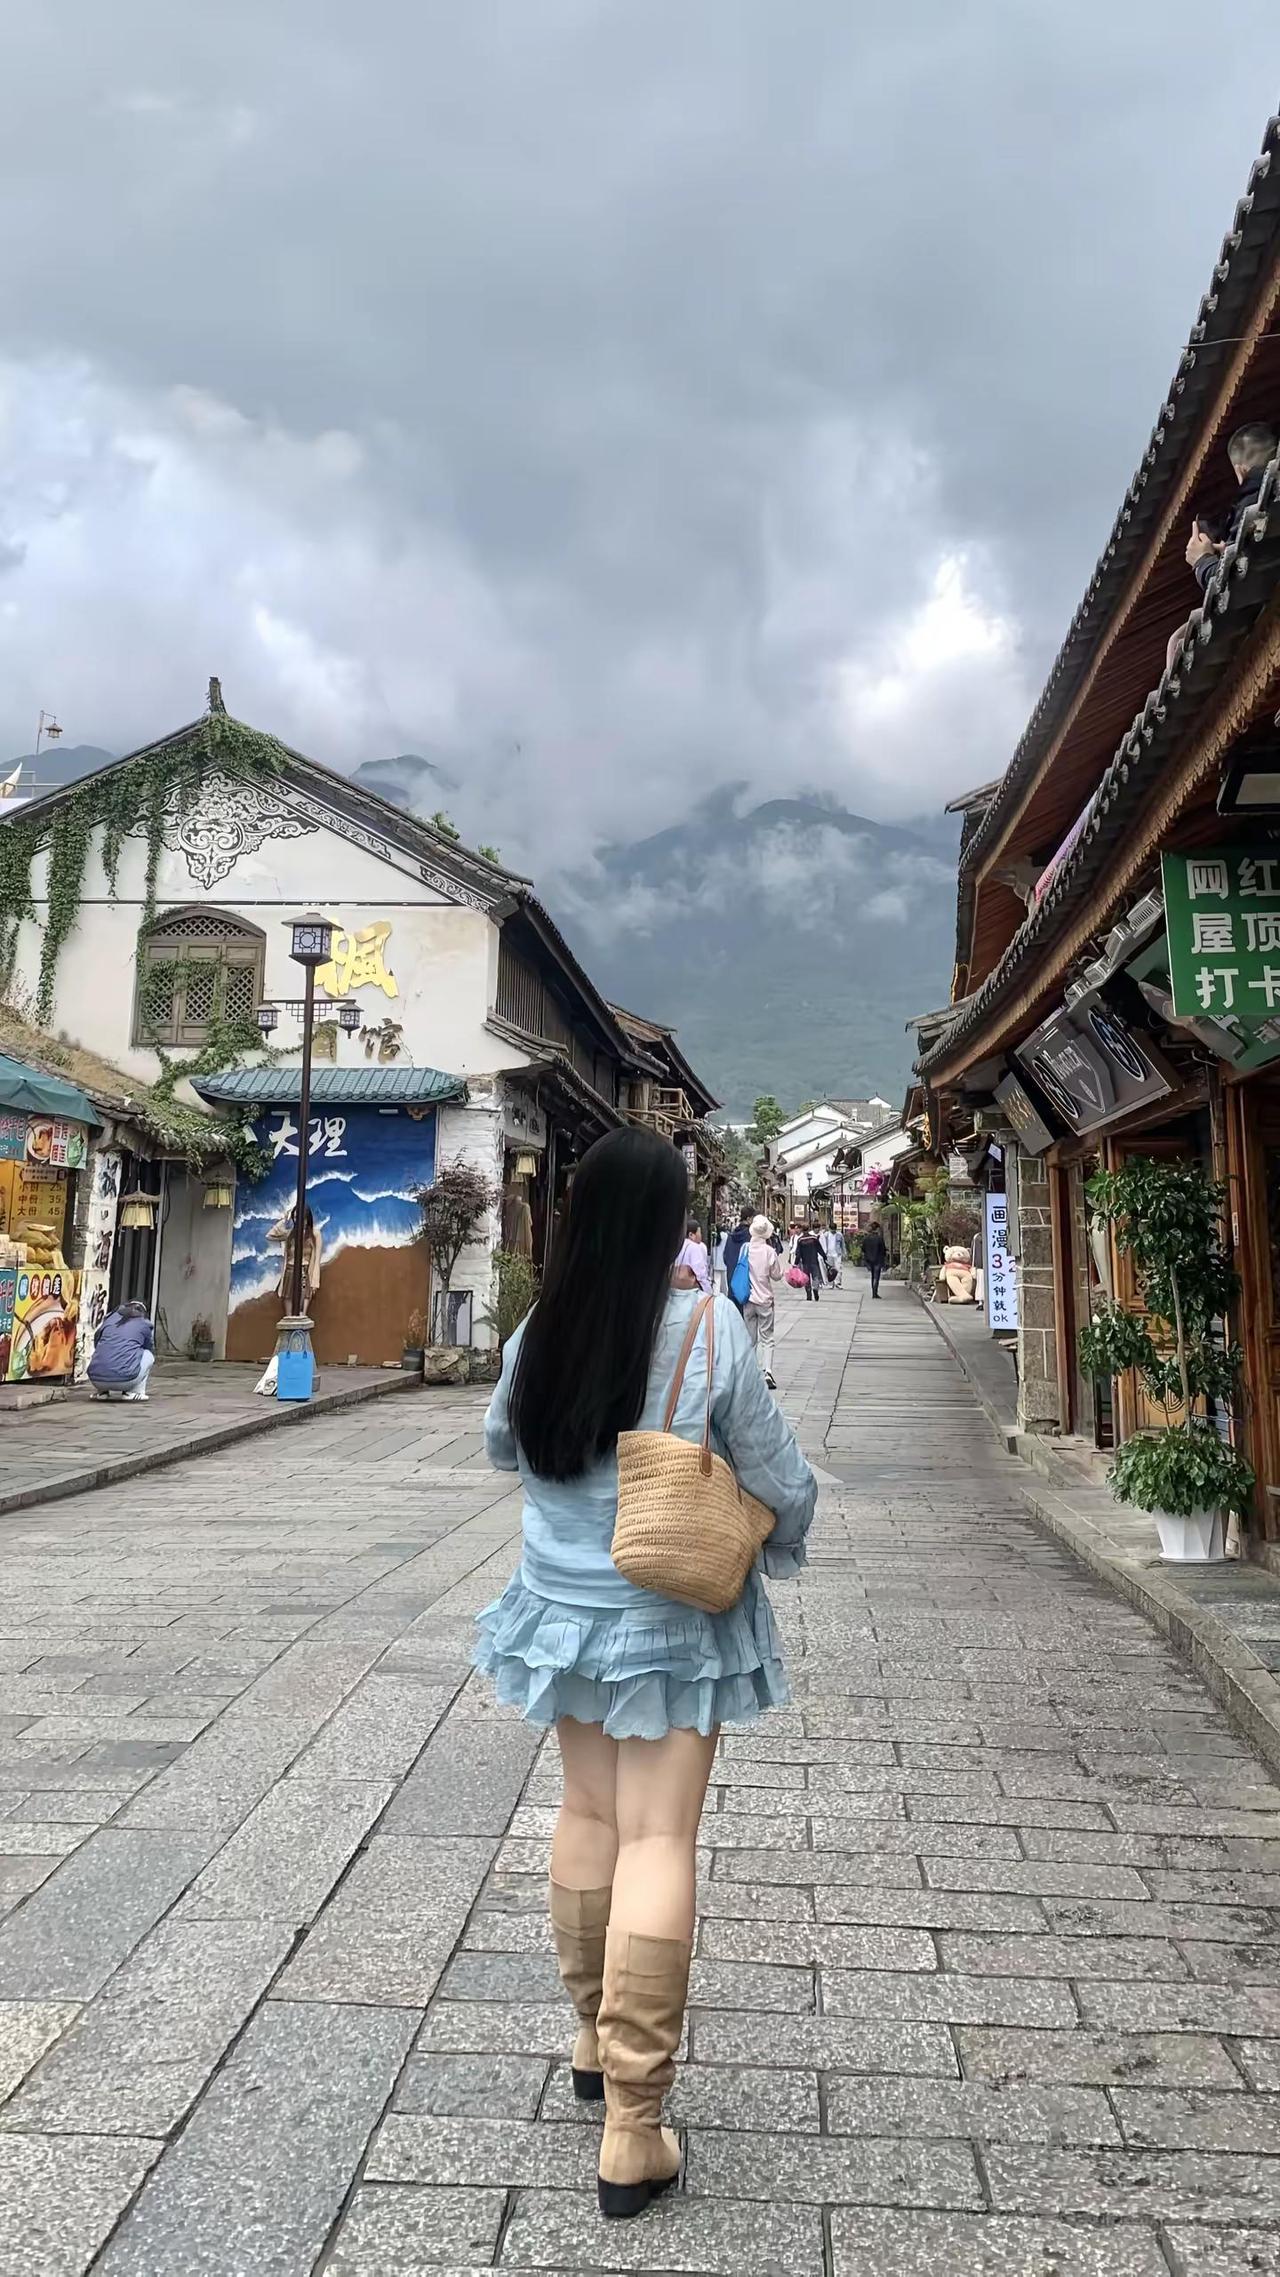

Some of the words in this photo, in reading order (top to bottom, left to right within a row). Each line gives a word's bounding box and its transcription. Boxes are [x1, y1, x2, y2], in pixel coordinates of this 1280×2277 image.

[1187, 857, 1280, 900] 网红
[1191, 912, 1280, 954] 屋顶
[1195, 965, 1280, 1009] 打卡
